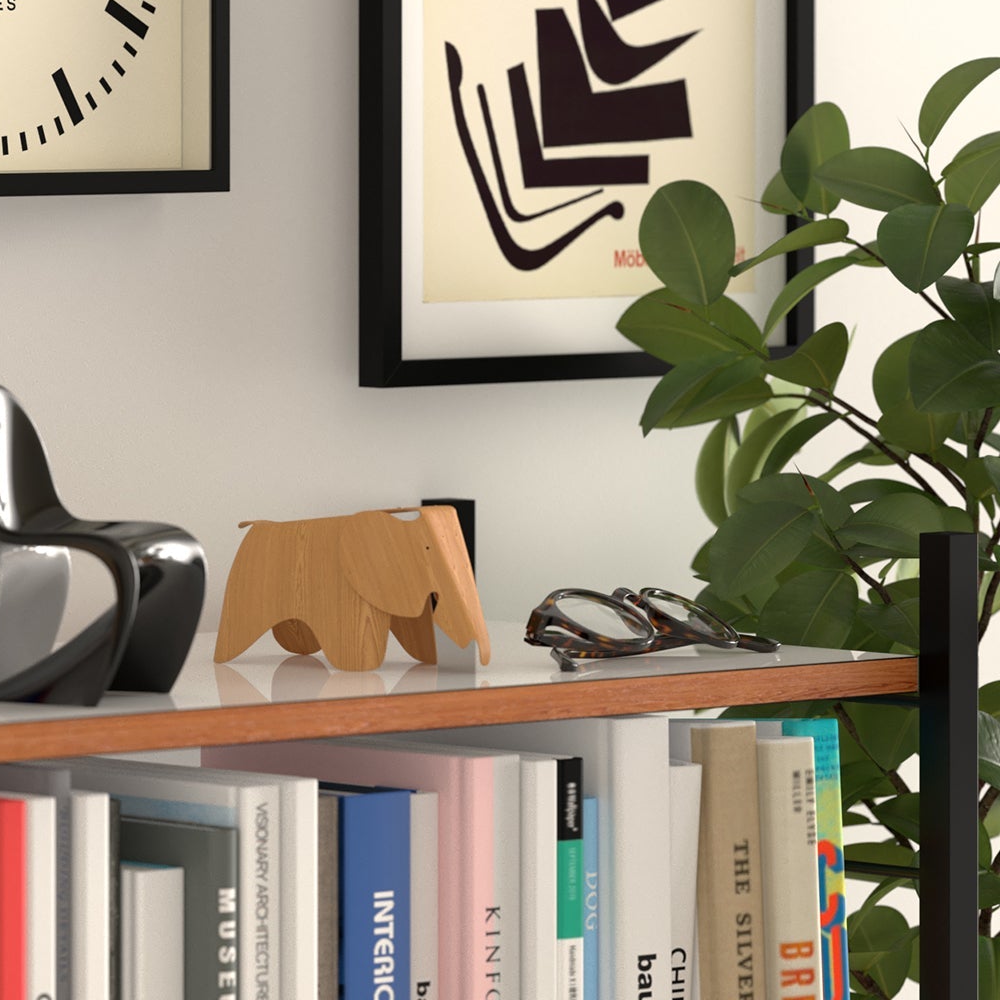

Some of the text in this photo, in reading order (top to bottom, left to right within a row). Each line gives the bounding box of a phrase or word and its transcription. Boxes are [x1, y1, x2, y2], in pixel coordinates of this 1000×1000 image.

[613, 249, 648, 268] Möb
[255, 803, 269, 881] VISIONARY
[734, 839, 751, 895] THE
[585, 872, 599, 931] DOG
[671, 947, 687, 1000] CHI
